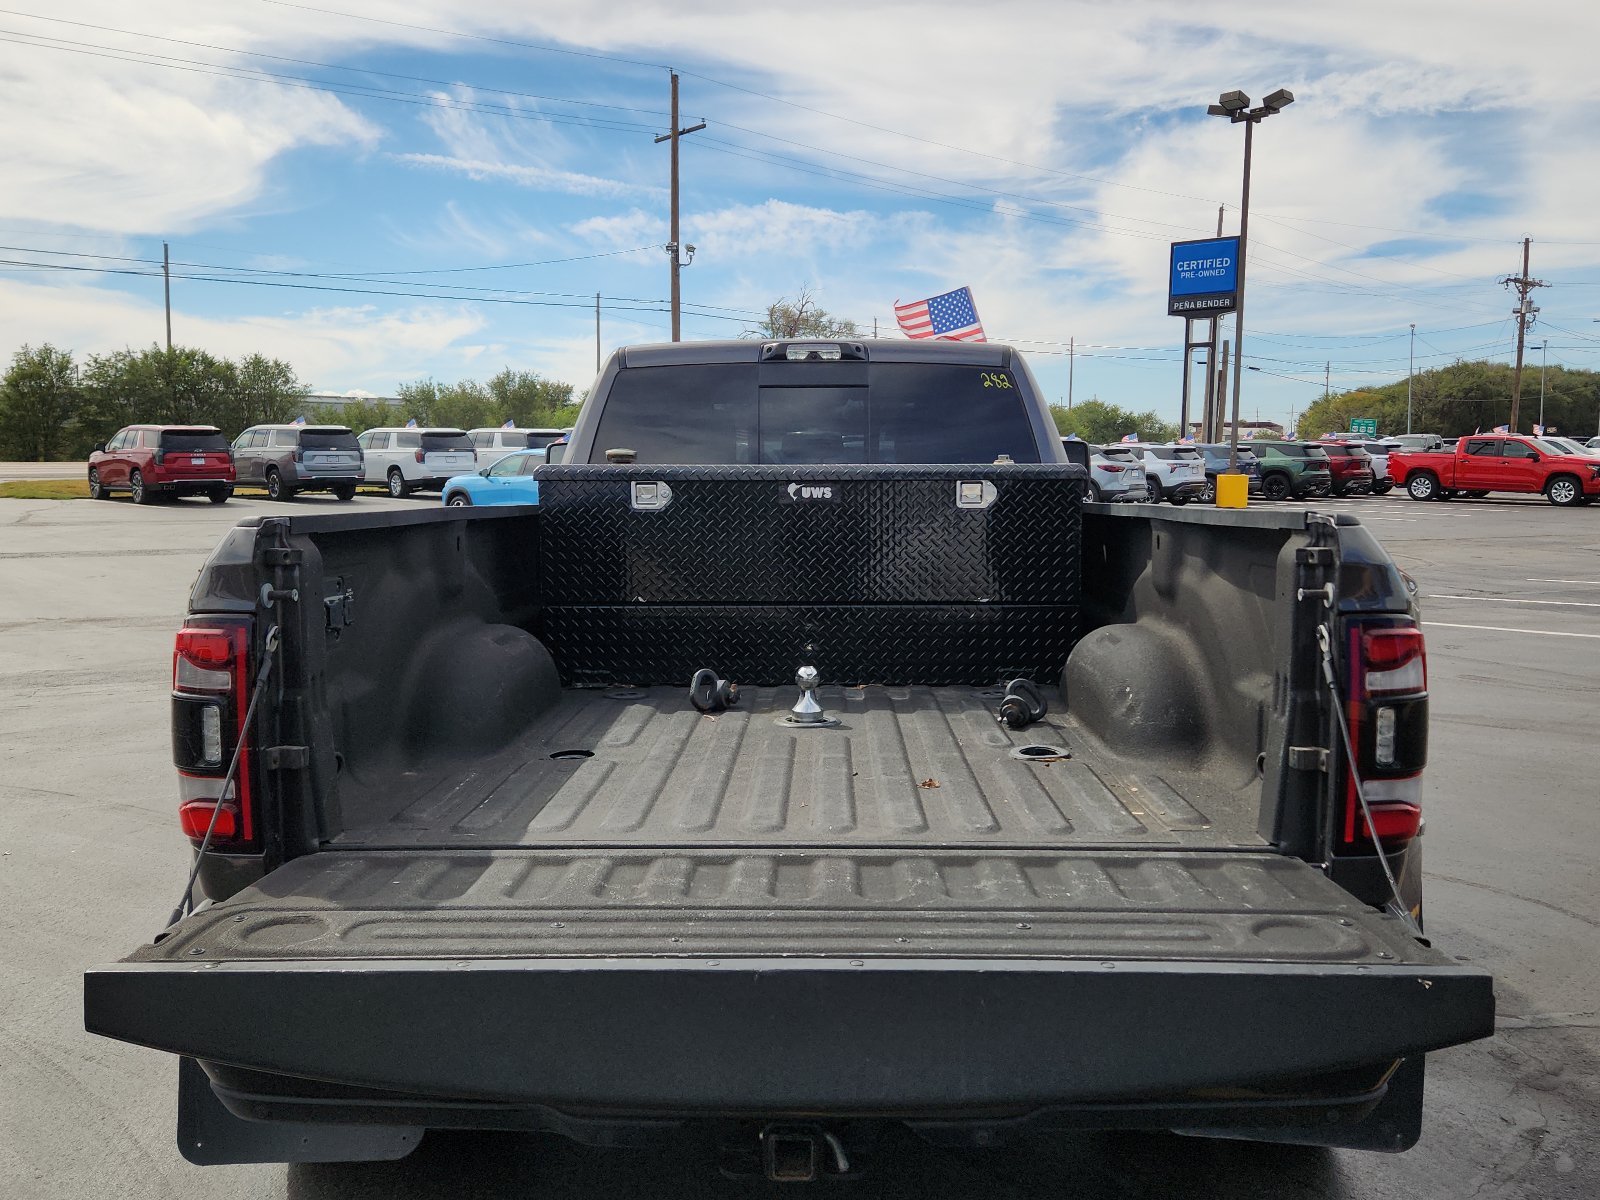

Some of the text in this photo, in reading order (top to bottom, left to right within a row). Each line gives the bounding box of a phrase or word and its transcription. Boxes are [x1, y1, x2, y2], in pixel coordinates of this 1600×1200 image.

[1177, 257, 1231, 271] CERTIFIED
[1180, 268, 1226, 279] PRE-OWNED
[1173, 298, 1230, 310] PEÑA BENDER
[980, 372, 1013, 389] 282
[801, 486, 833, 499] UWS
